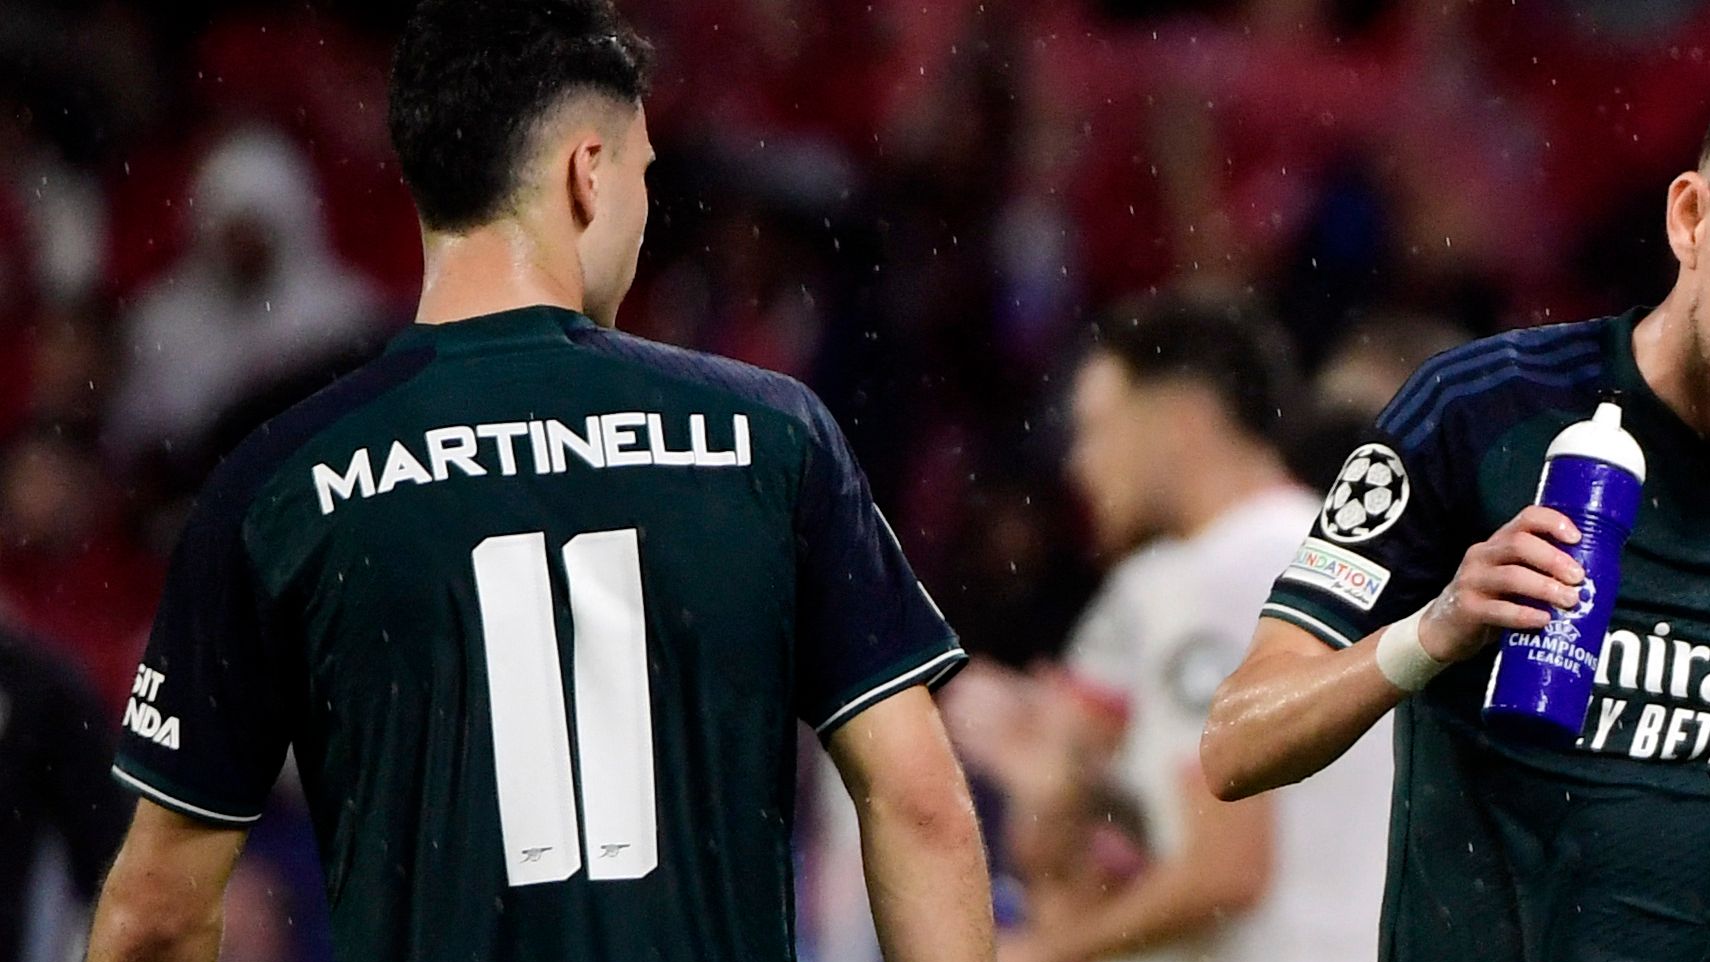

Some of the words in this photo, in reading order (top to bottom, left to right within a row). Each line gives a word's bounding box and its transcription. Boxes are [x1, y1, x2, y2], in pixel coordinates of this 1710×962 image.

[311, 411, 752, 516] MARTINELLI
[1508, 632, 1598, 671] CHAMPIONS
[1527, 649, 1581, 675] LEAGUE
[472, 528, 658, 887] 11
